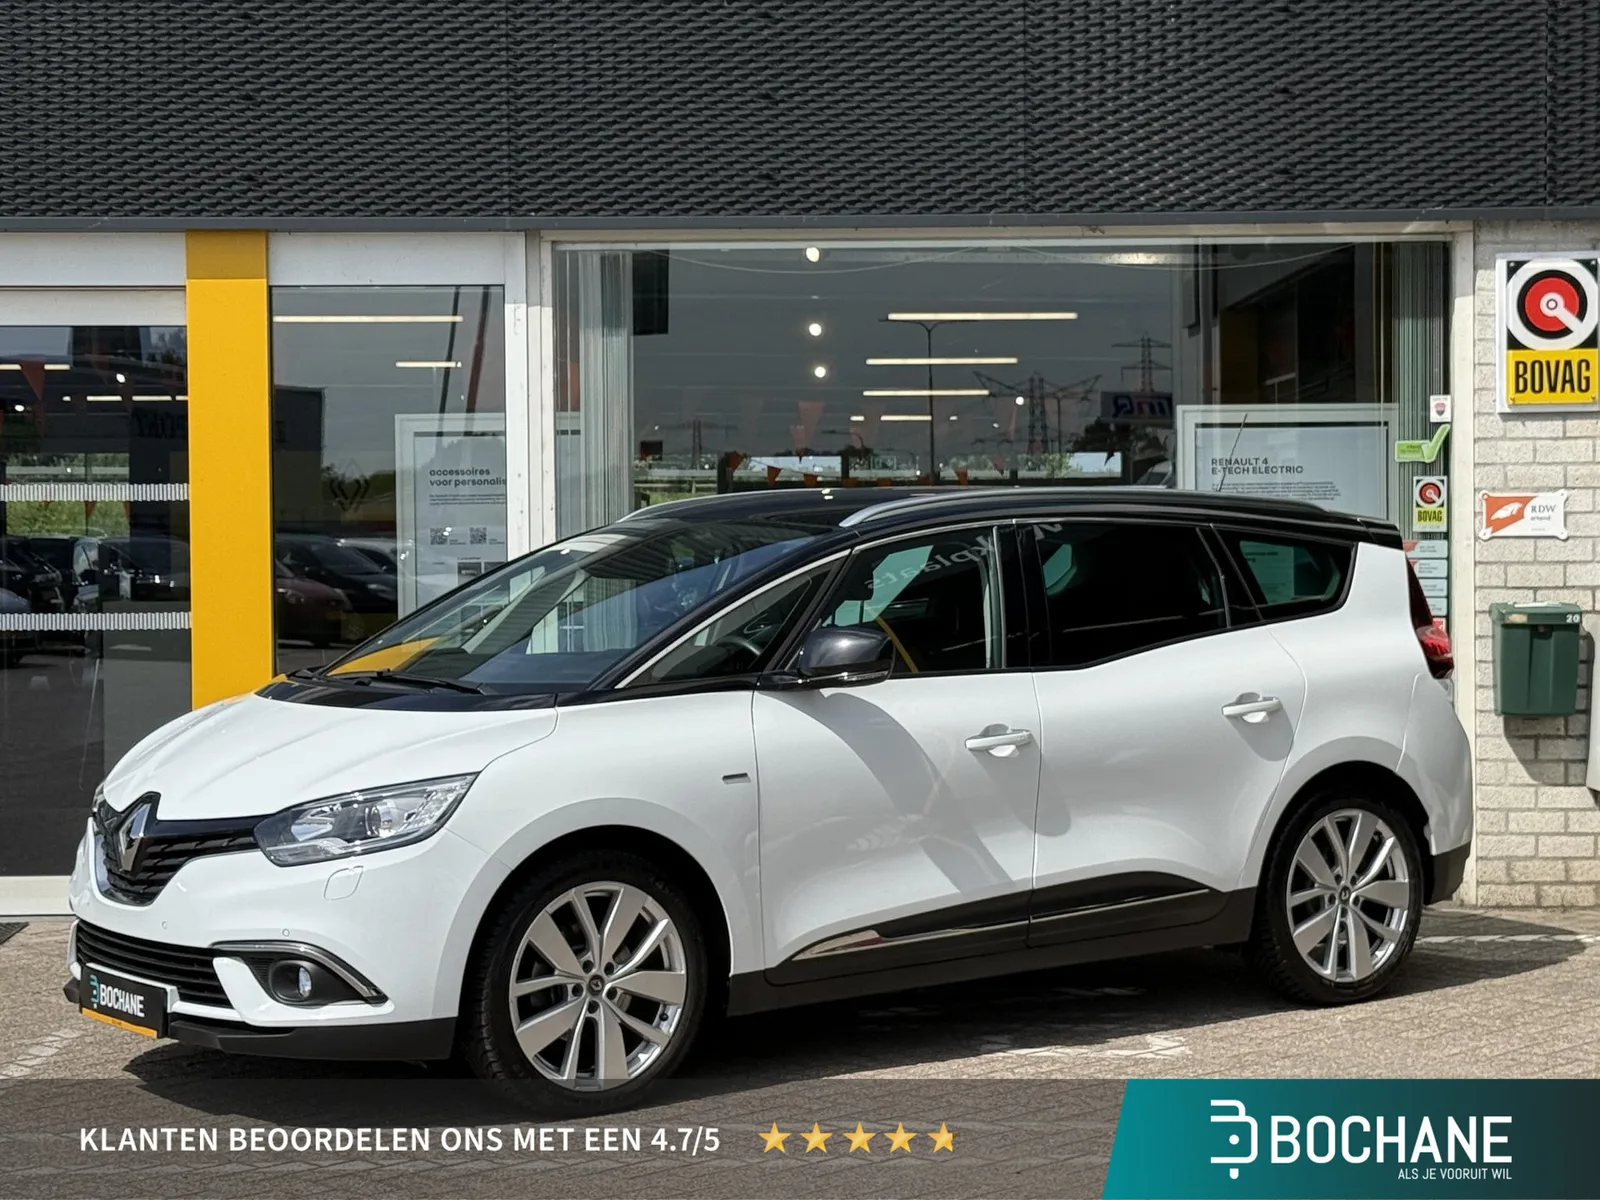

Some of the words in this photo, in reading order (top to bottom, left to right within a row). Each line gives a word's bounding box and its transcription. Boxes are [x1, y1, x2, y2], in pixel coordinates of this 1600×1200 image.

[1514, 358, 1591, 395] BOVAG
[1211, 458, 1258, 466] RENAULT
[1261, 457, 1269, 466] 4
[429, 468, 490, 476] accessoires
[1211, 466, 1250, 475] E-TECH
[1251, 465, 1304, 475] ELECTRIC
[1530, 503, 1557, 514] RDW
[1417, 509, 1443, 523] BOVAG
[1565, 613, 1581, 624] 20
[100, 983, 146, 1018] BOCHANE
